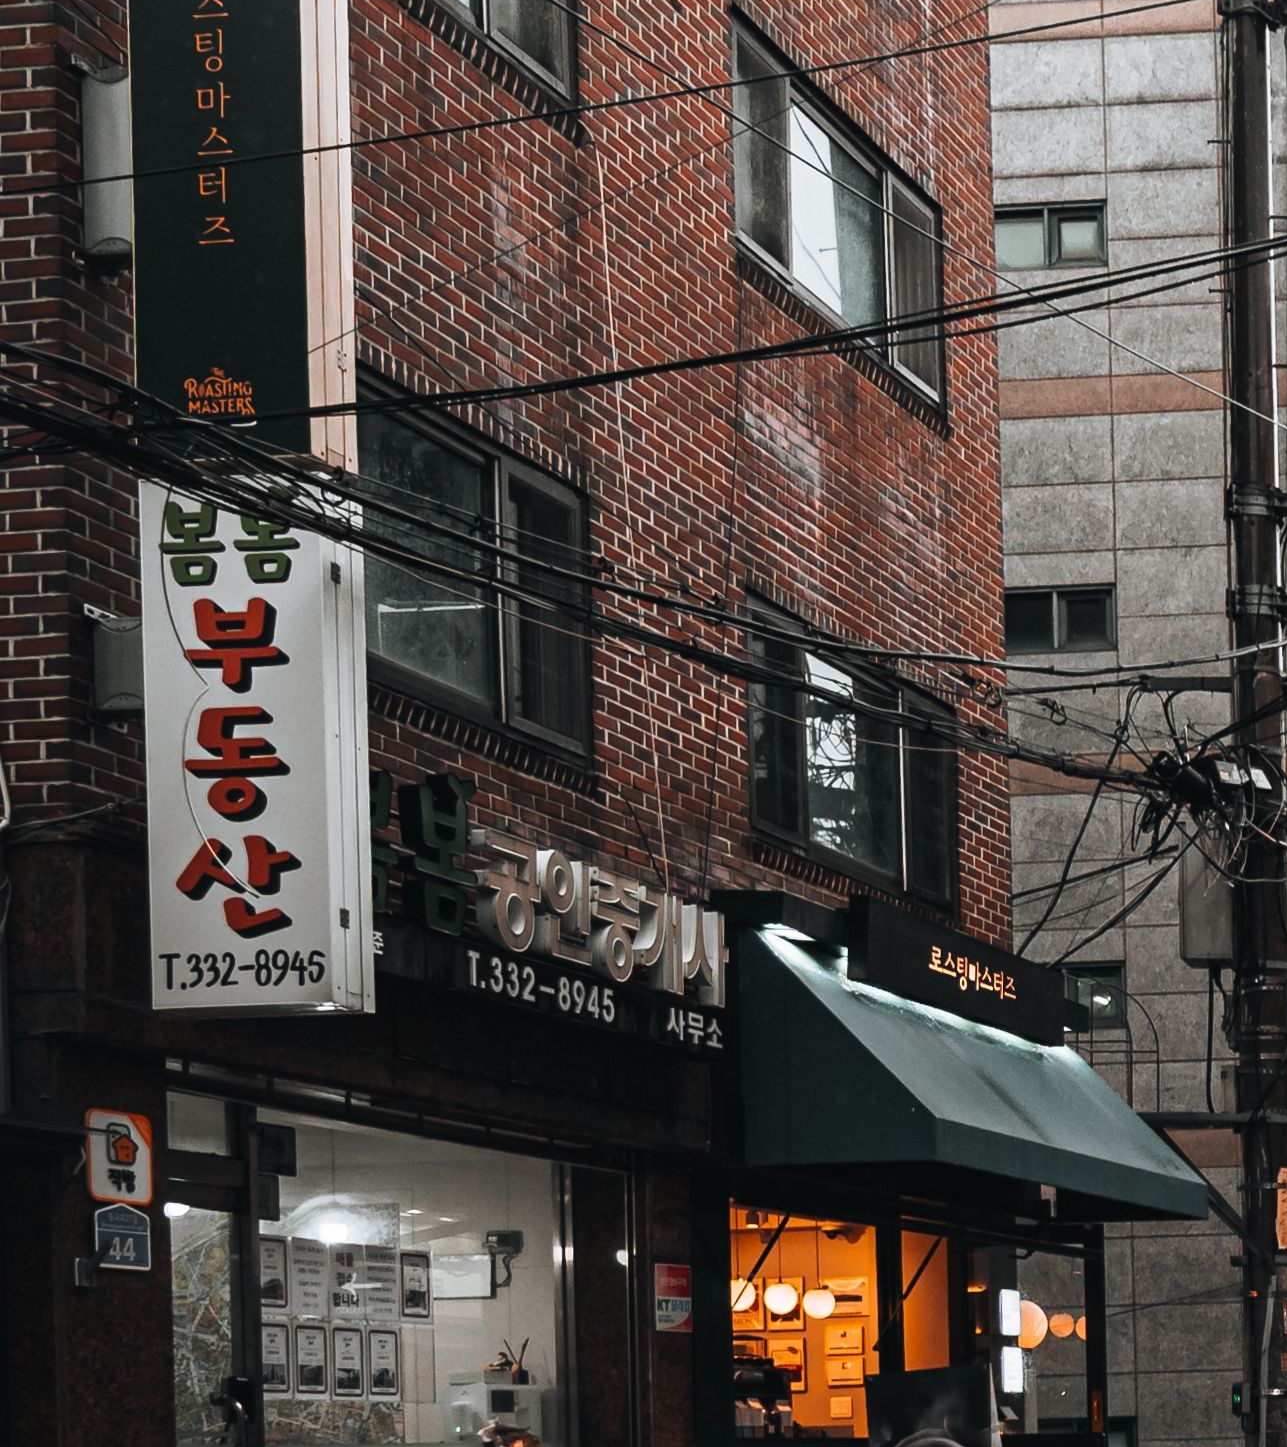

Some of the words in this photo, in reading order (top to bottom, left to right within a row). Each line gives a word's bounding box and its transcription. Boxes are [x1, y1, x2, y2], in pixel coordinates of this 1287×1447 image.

[187, 396, 256, 415] MASTERS
[175, 596, 303, 939] 부동산
[468, 828, 730, 1009] 공인중개사
[158, 948, 326, 991] T.332-8945
[467, 949, 615, 1023] T.332-8945
[928, 945, 1017, 1000] 로스팅마스터즈
[666, 1006, 724, 1050] 사무소
[108, 1235, 137, 1262] 44
